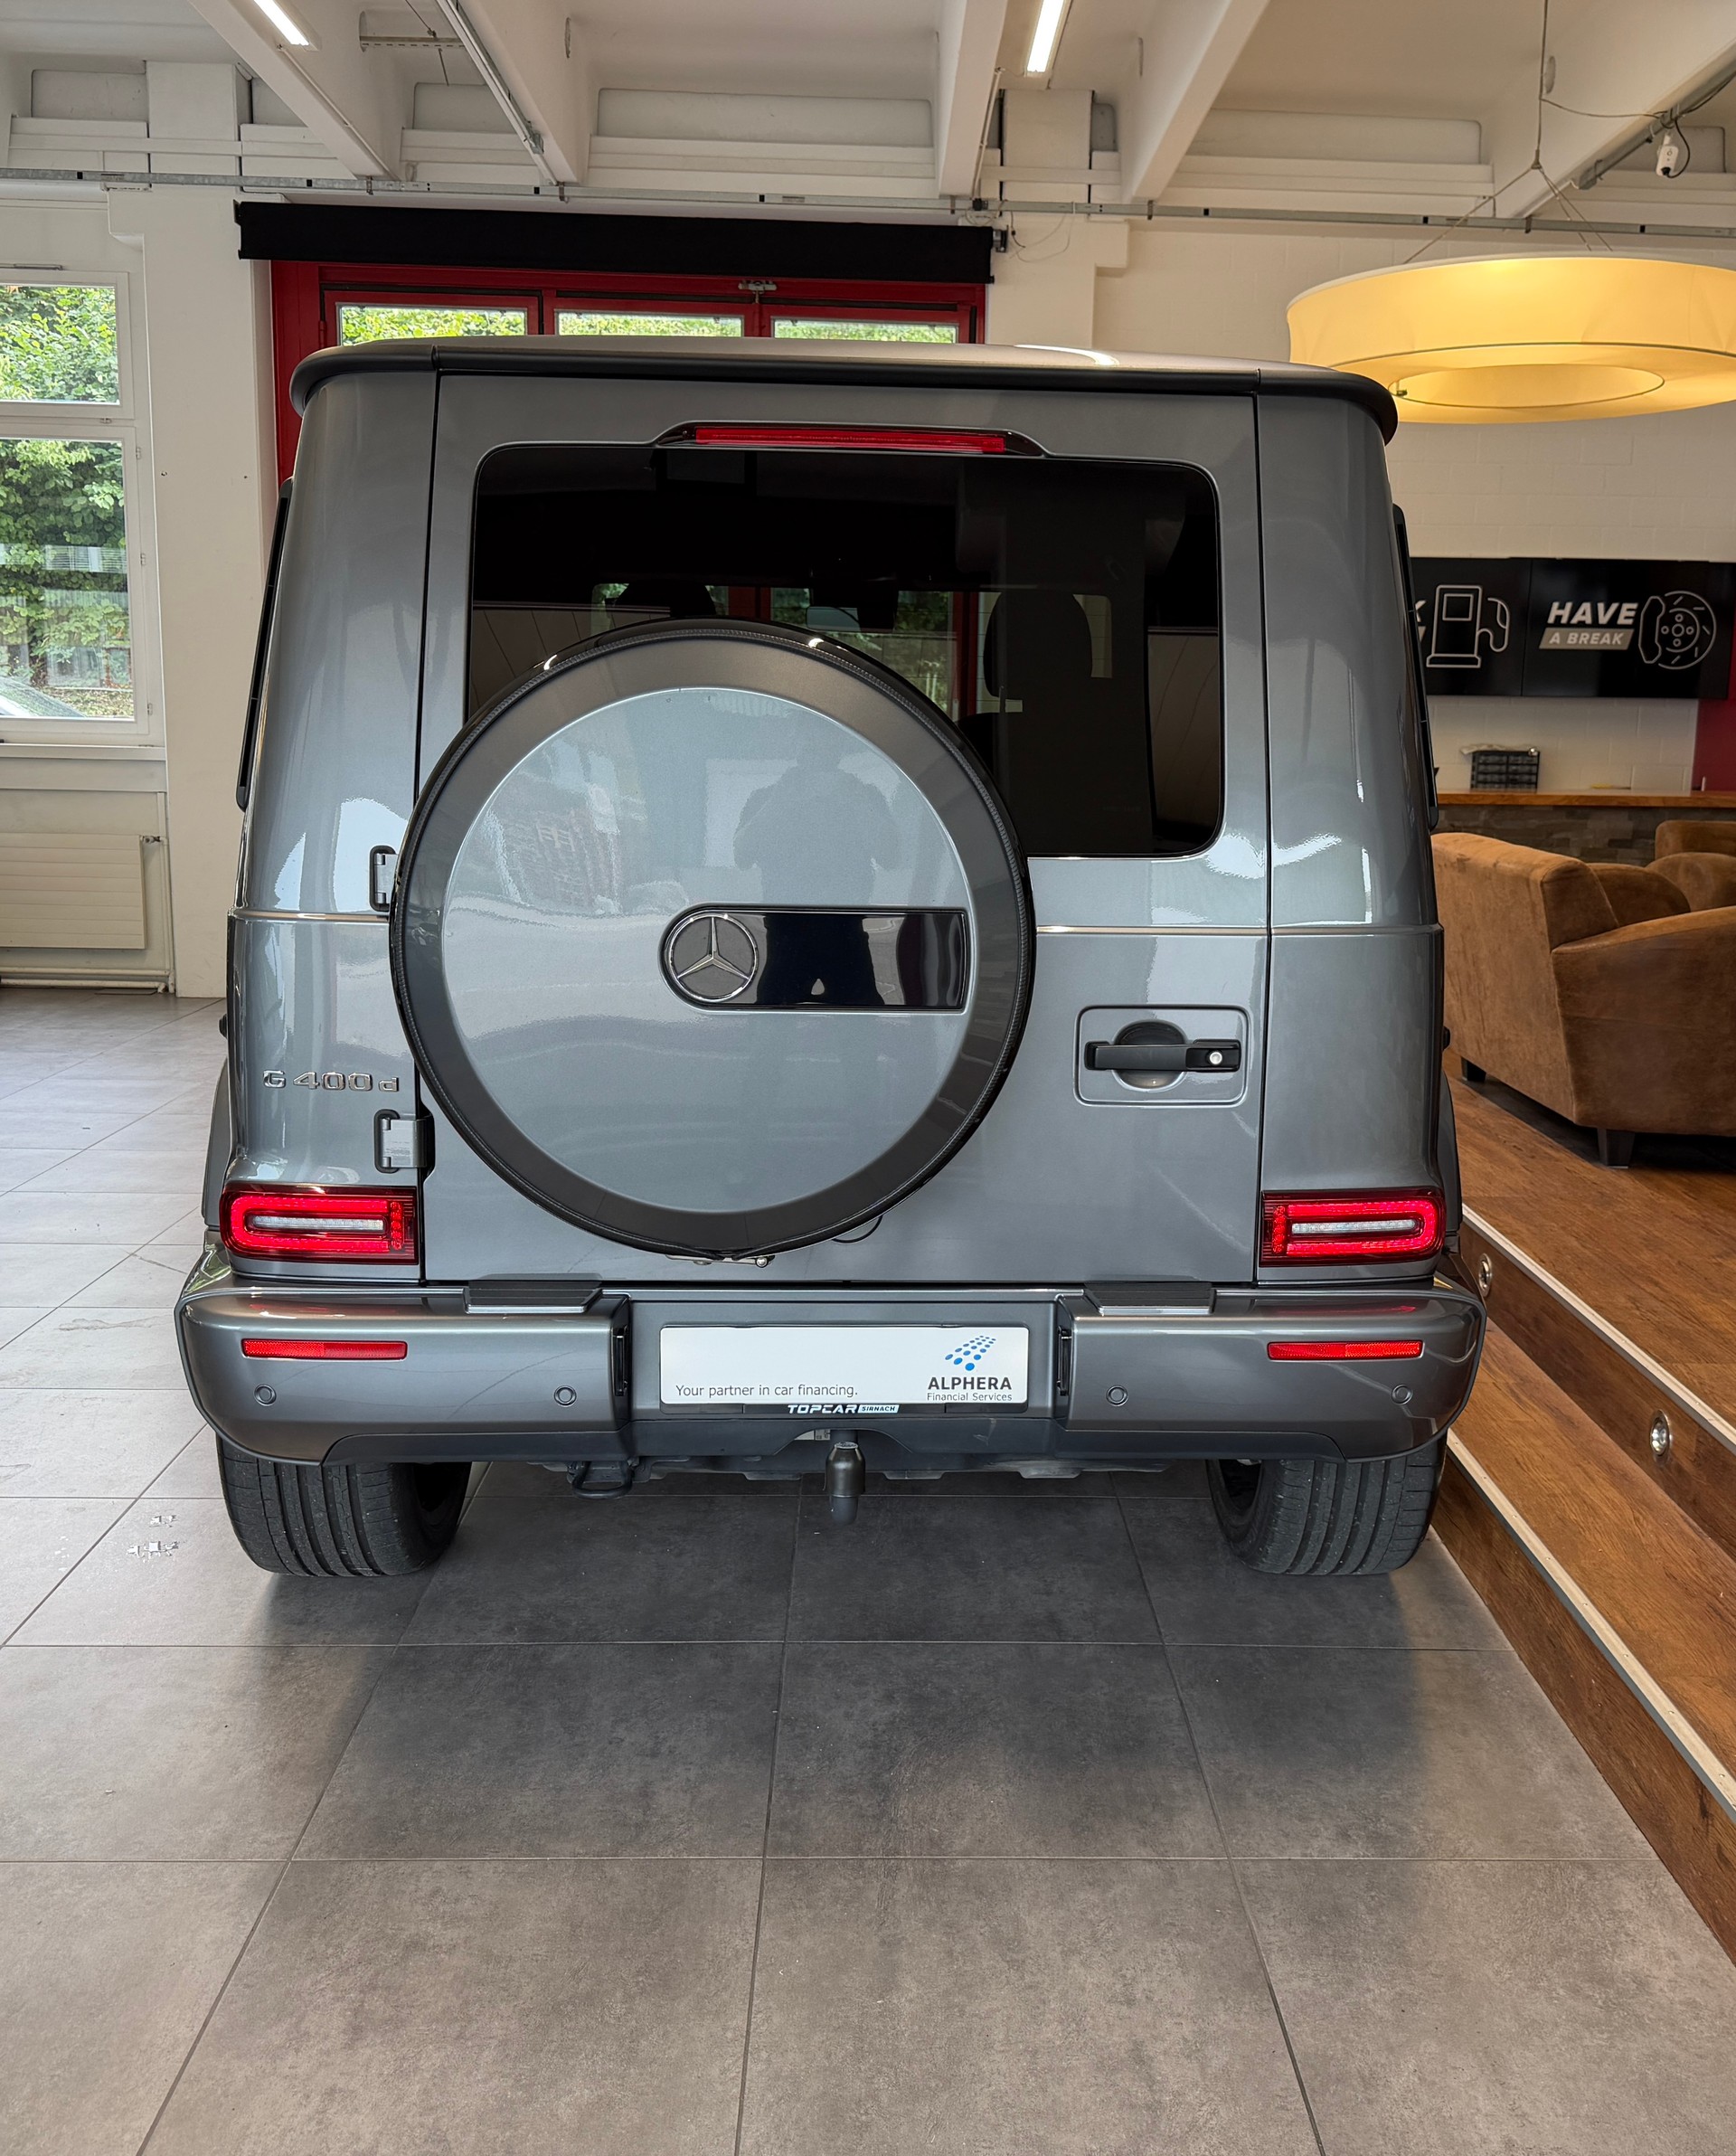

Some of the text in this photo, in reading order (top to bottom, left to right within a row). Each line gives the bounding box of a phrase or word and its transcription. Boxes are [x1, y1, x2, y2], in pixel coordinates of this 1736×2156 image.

[1547, 601, 1638, 625] HAVE
[1549, 632, 1624, 645] A BREAK
[263, 1070, 286, 1089] G
[928, 1376, 1012, 1390] ALPHERA
[675, 1385, 858, 1398] Your partner in car financing.
[927, 1393, 1012, 1401] Financial Services
[788, 1404, 857, 1414] TOPCAR
